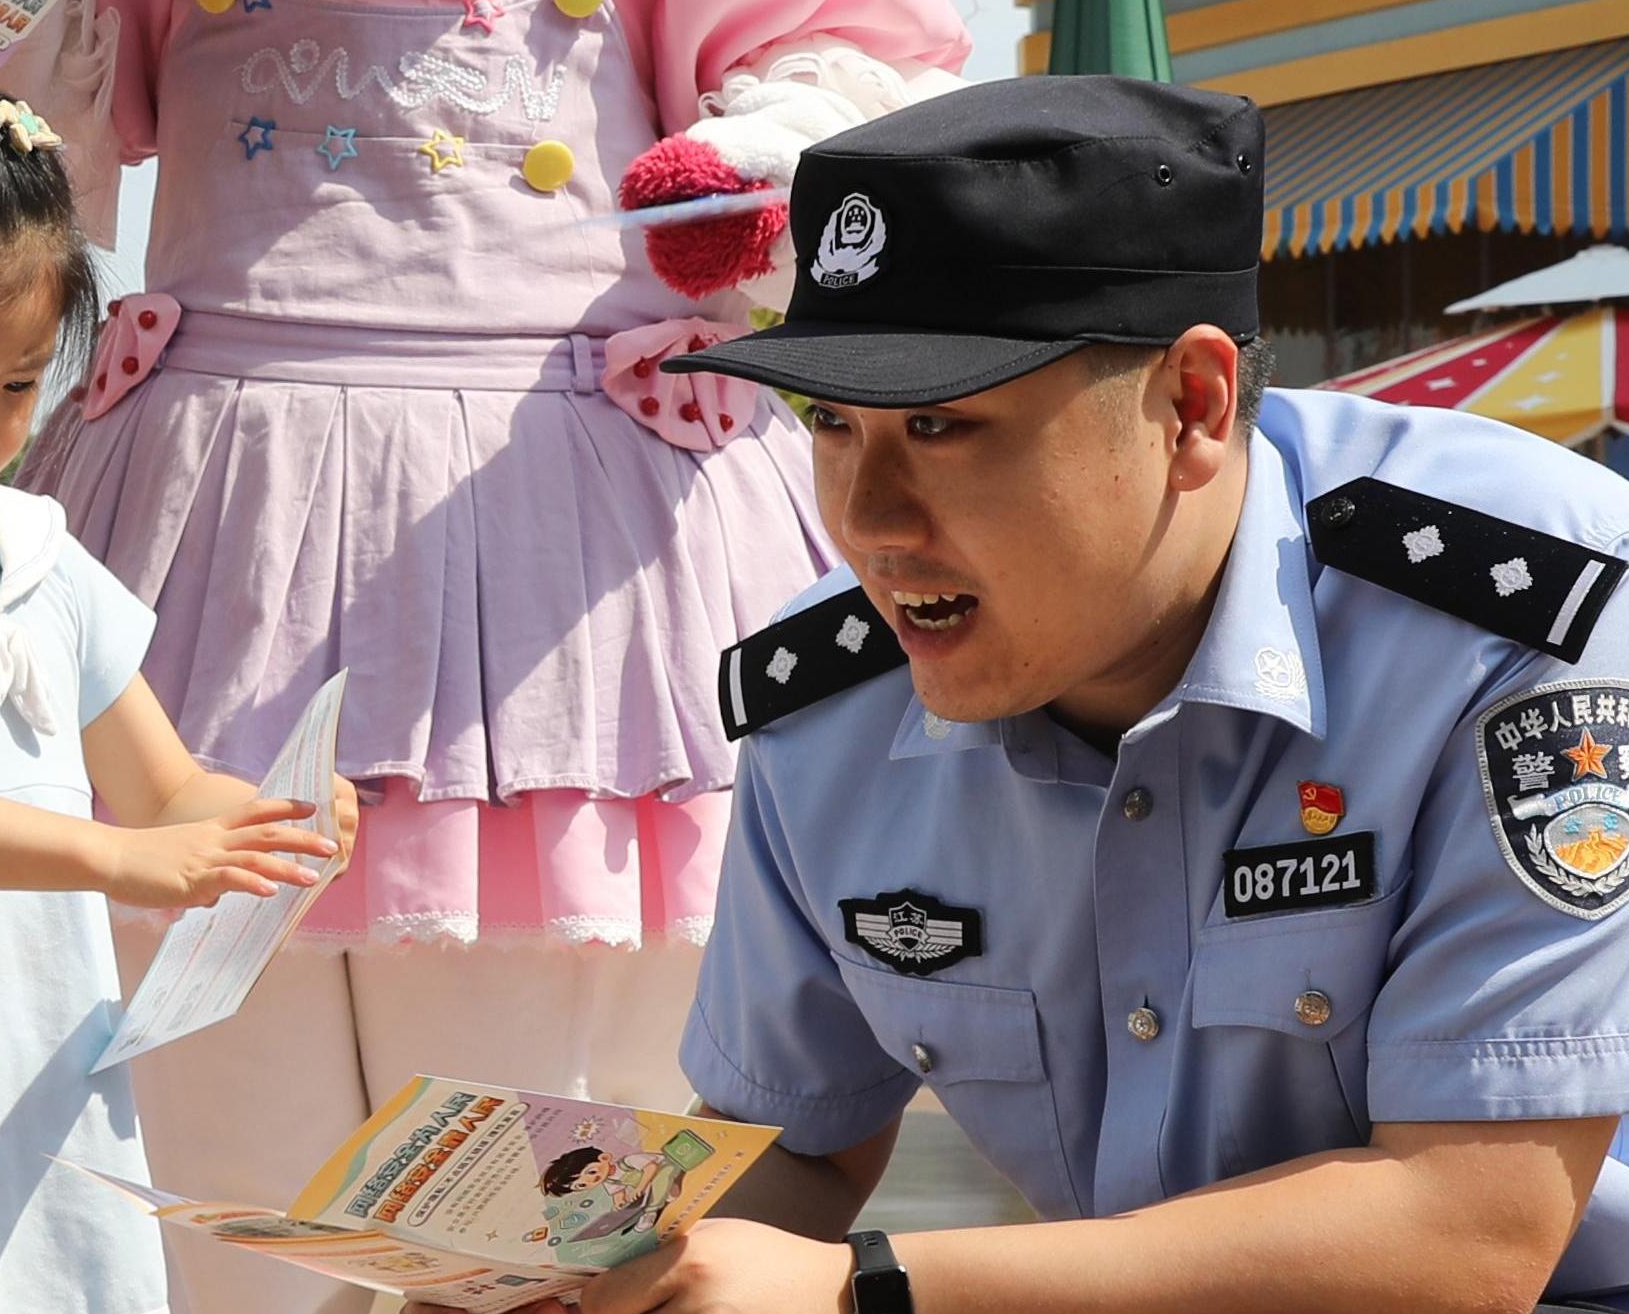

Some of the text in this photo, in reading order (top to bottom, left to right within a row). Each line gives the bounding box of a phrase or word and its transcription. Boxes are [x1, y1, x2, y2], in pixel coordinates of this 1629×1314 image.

[822, 275, 856, 285] POLICE
[1513, 751, 1555, 792] 警
[1553, 786, 1622, 812] POLICE
[1234, 850, 1361, 902] 087121
[894, 928, 922, 938] POLICE
[343, 1090, 478, 1217] 网络安全为人民
